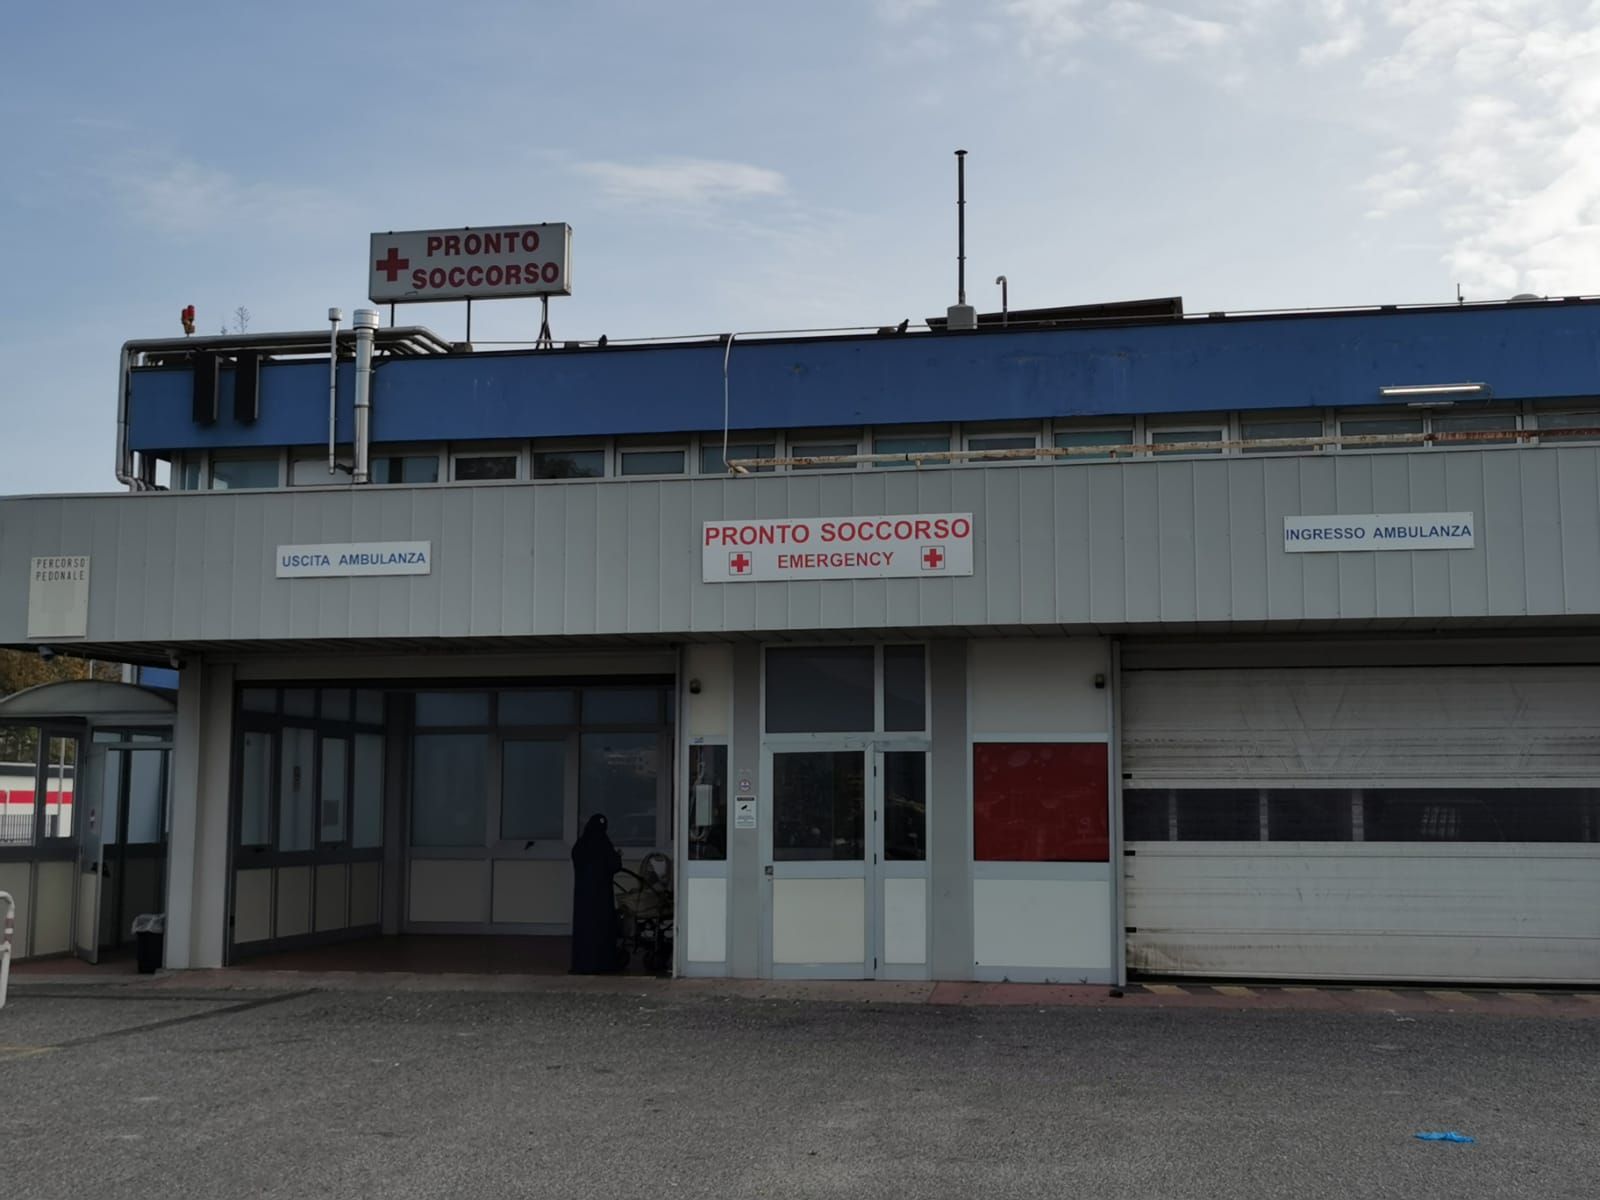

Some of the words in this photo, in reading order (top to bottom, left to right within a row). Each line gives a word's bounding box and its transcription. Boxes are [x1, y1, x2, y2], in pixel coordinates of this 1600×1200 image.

[427, 230, 540, 256] PRONTO
[412, 262, 559, 289] SOCCORSO
[705, 524, 810, 546] PRONTO
[820, 518, 970, 542] SOCCORSO
[1286, 527, 1365, 540] INGRESSO
[1373, 525, 1471, 538] AMBULANZA
[36, 558, 85, 569] PERCORSO
[282, 555, 330, 567] USCITA
[339, 552, 426, 566] AMBULANZA
[777, 551, 895, 569] EMERGENCY
[36, 571, 84, 581] PEDONALE
